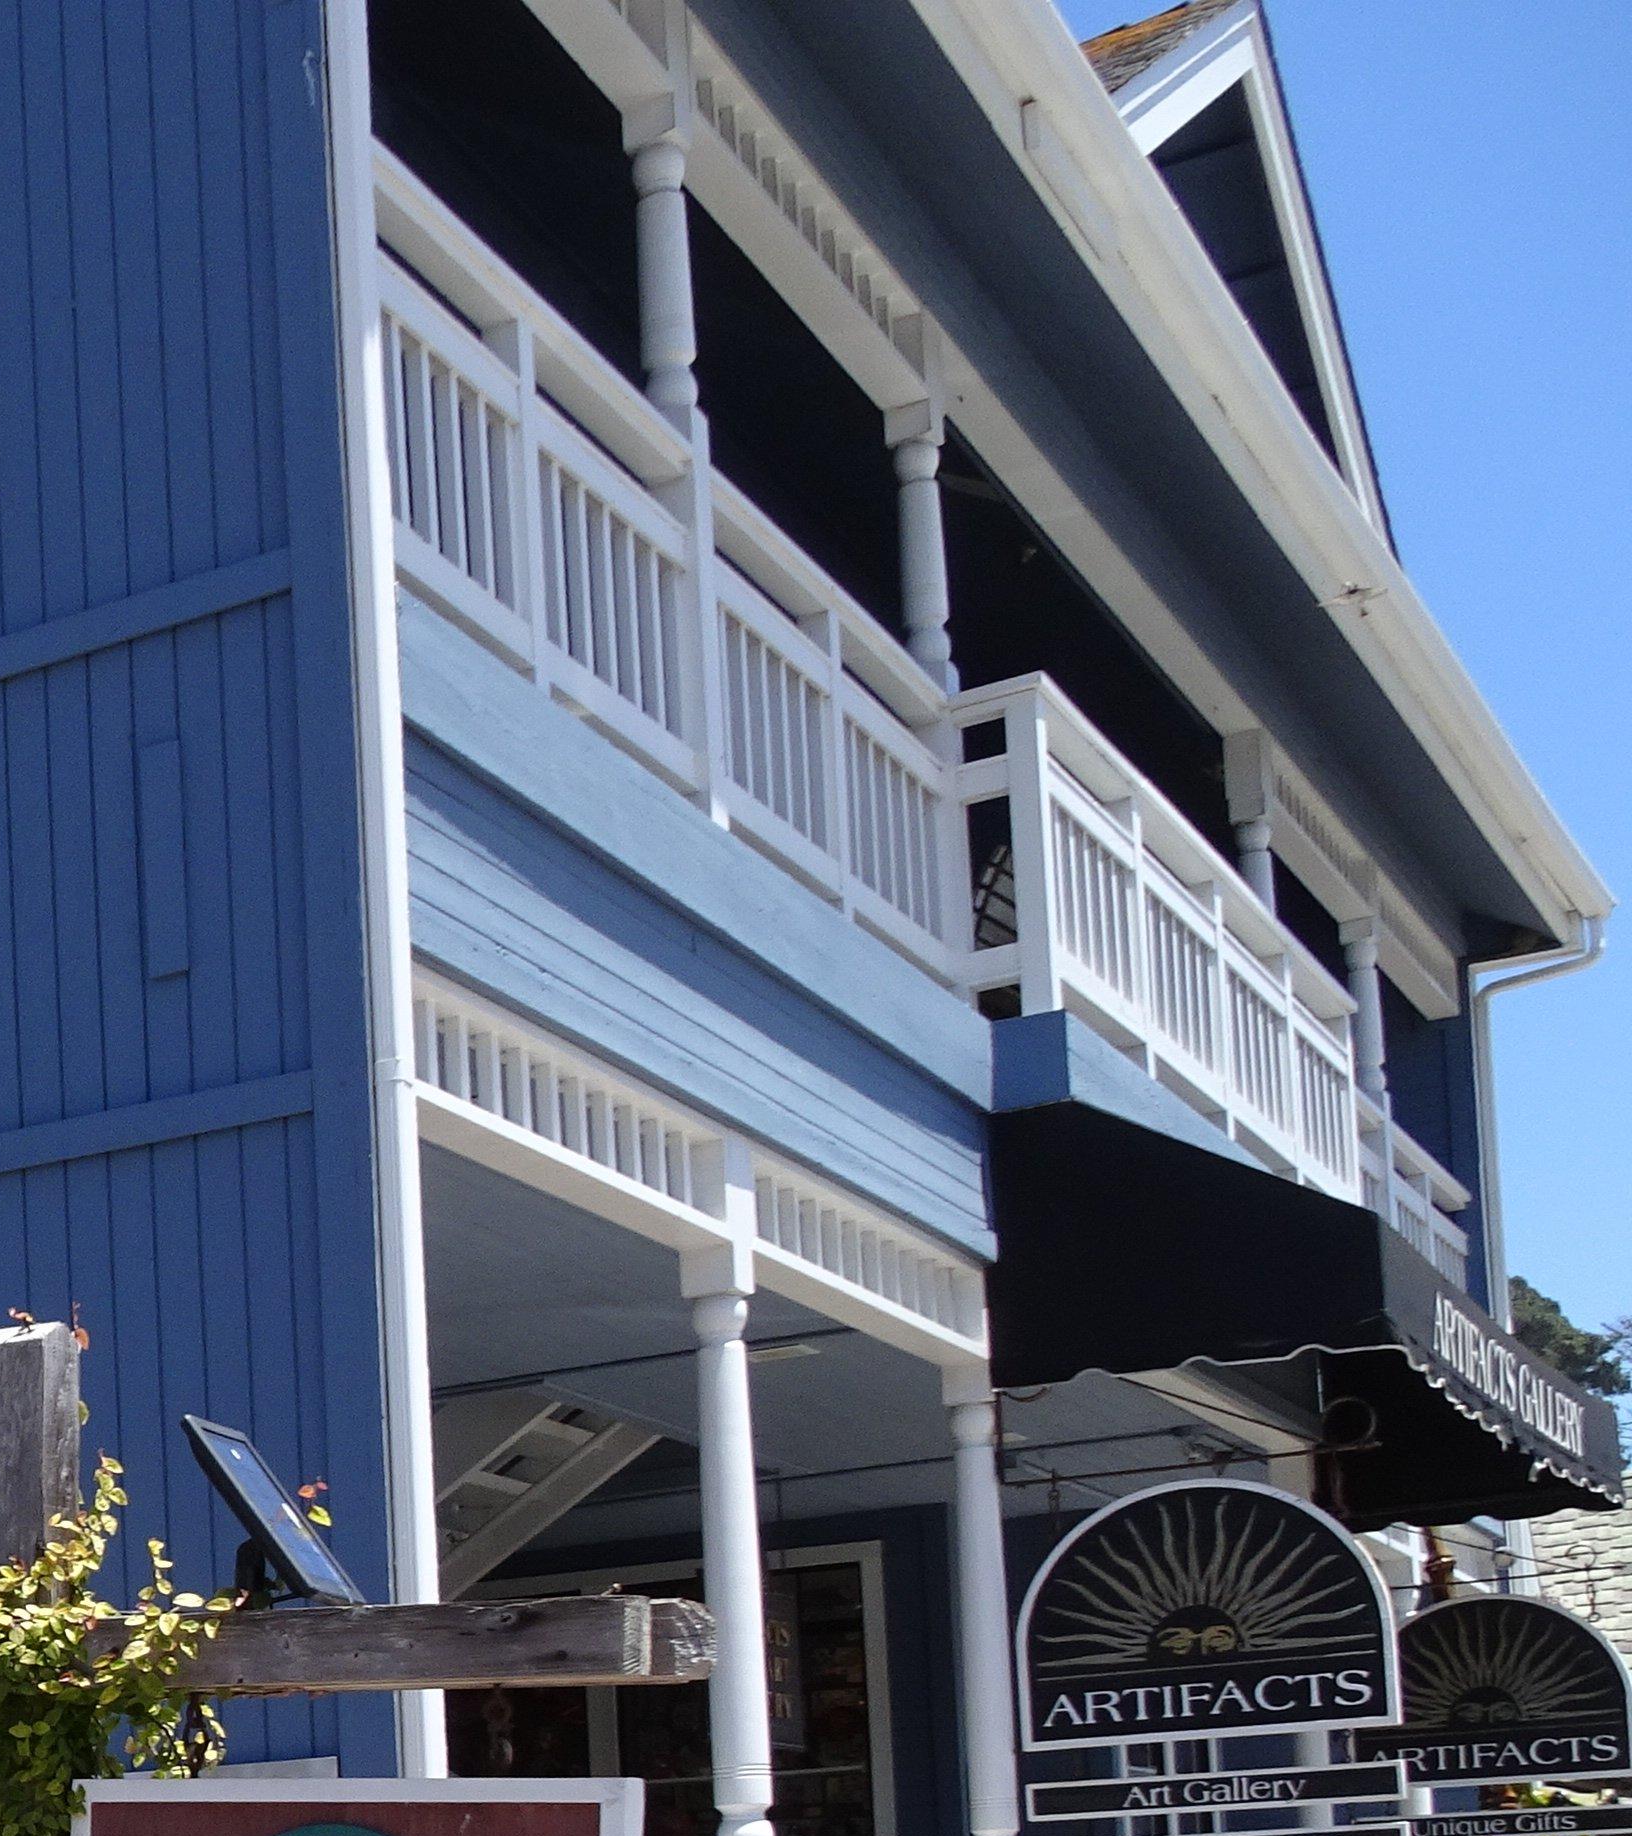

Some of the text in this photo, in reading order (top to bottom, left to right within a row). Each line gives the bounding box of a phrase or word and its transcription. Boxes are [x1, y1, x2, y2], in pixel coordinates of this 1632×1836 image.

[1434, 1290, 1585, 1457] ARTIFACTS GALLERY
[1042, 1668, 1373, 1728] ARTIFACTS
[1123, 1775, 1306, 1809] Art Gallery
[1515, 1811, 1577, 1832] Gifts
